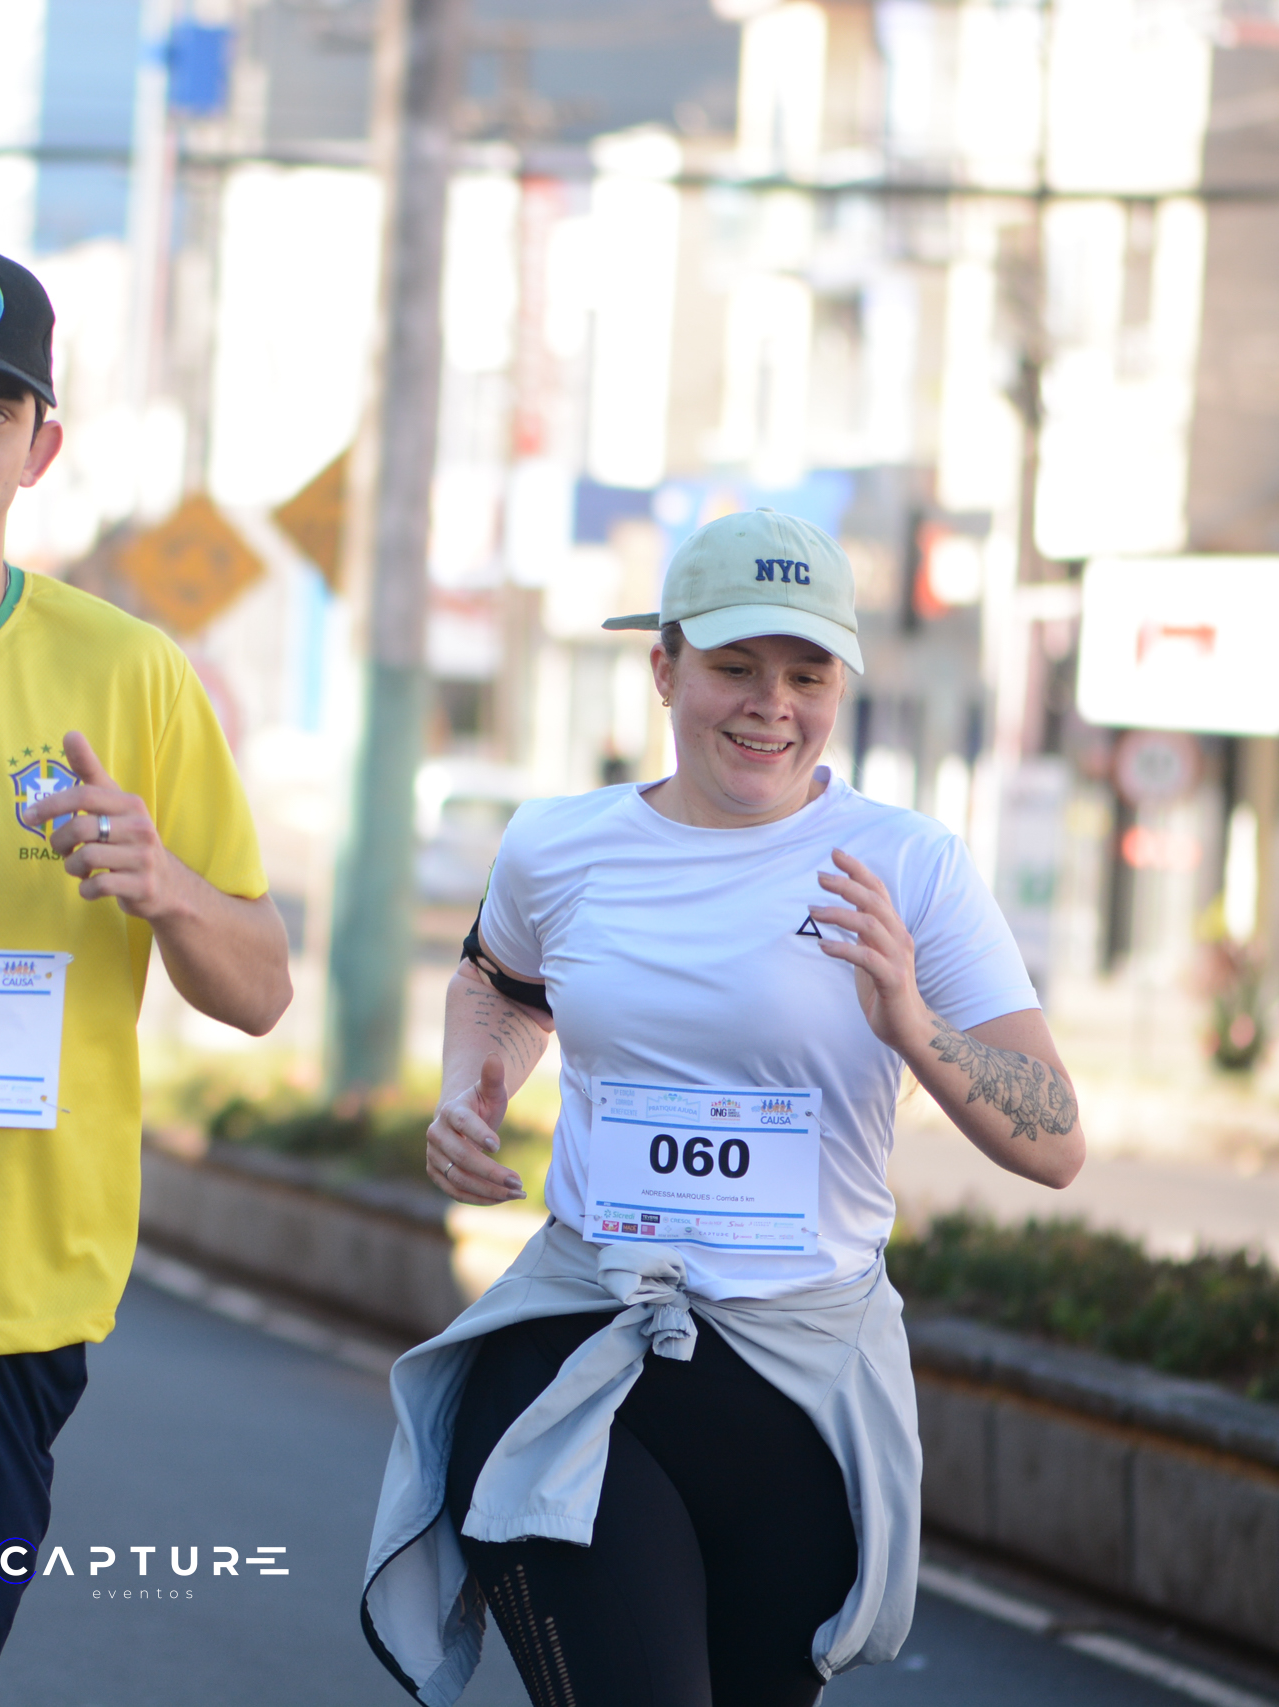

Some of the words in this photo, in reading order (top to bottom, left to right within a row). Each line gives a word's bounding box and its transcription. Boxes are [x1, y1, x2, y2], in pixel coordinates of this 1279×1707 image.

[755, 558, 810, 585] NYC
[19, 847, 65, 860] BRAS
[1, 978, 34, 986] CAUSA
[677, 1107, 697, 1115] AJUDA
[711, 1108, 727, 1118] ONG
[761, 1116, 791, 1125] CAUSA
[649, 1133, 750, 1178] 060
[641, 1189, 675, 1198] ANDRESSA
[676, 1192, 711, 1201] MARQUES
[716, 1194, 739, 1202] Corrida
[613, 1210, 635, 1220] Sicredi
